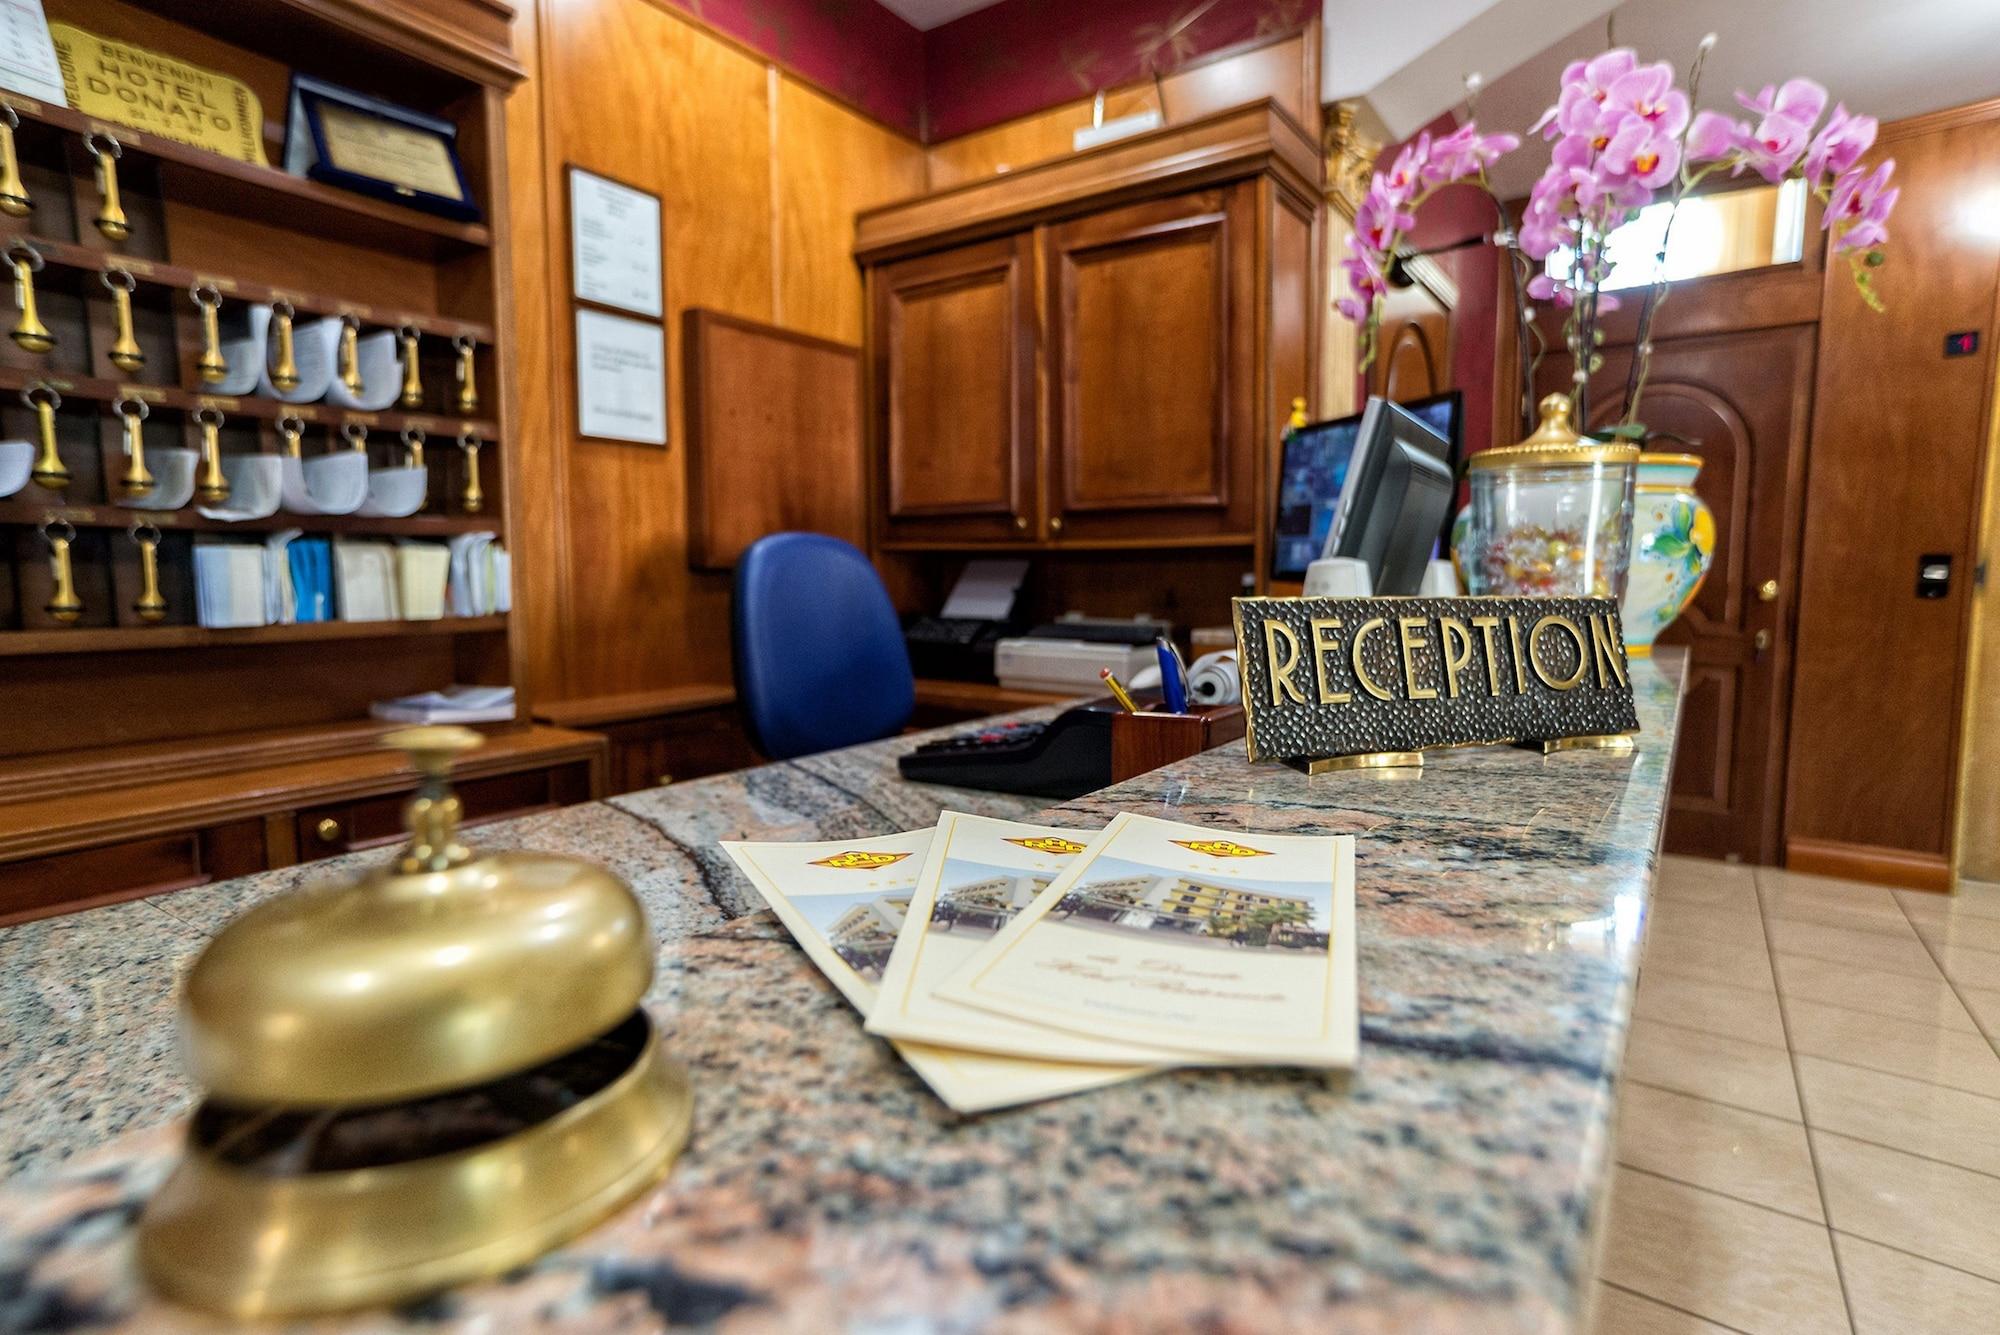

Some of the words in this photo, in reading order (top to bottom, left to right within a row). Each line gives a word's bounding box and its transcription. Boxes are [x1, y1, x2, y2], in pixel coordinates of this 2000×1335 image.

[97, 59, 218, 110] HOTEL
[100, 44, 213, 90] BENVENUTI
[87, 76, 232, 132] DONATO
[1264, 614, 1626, 706] RECEPTION
